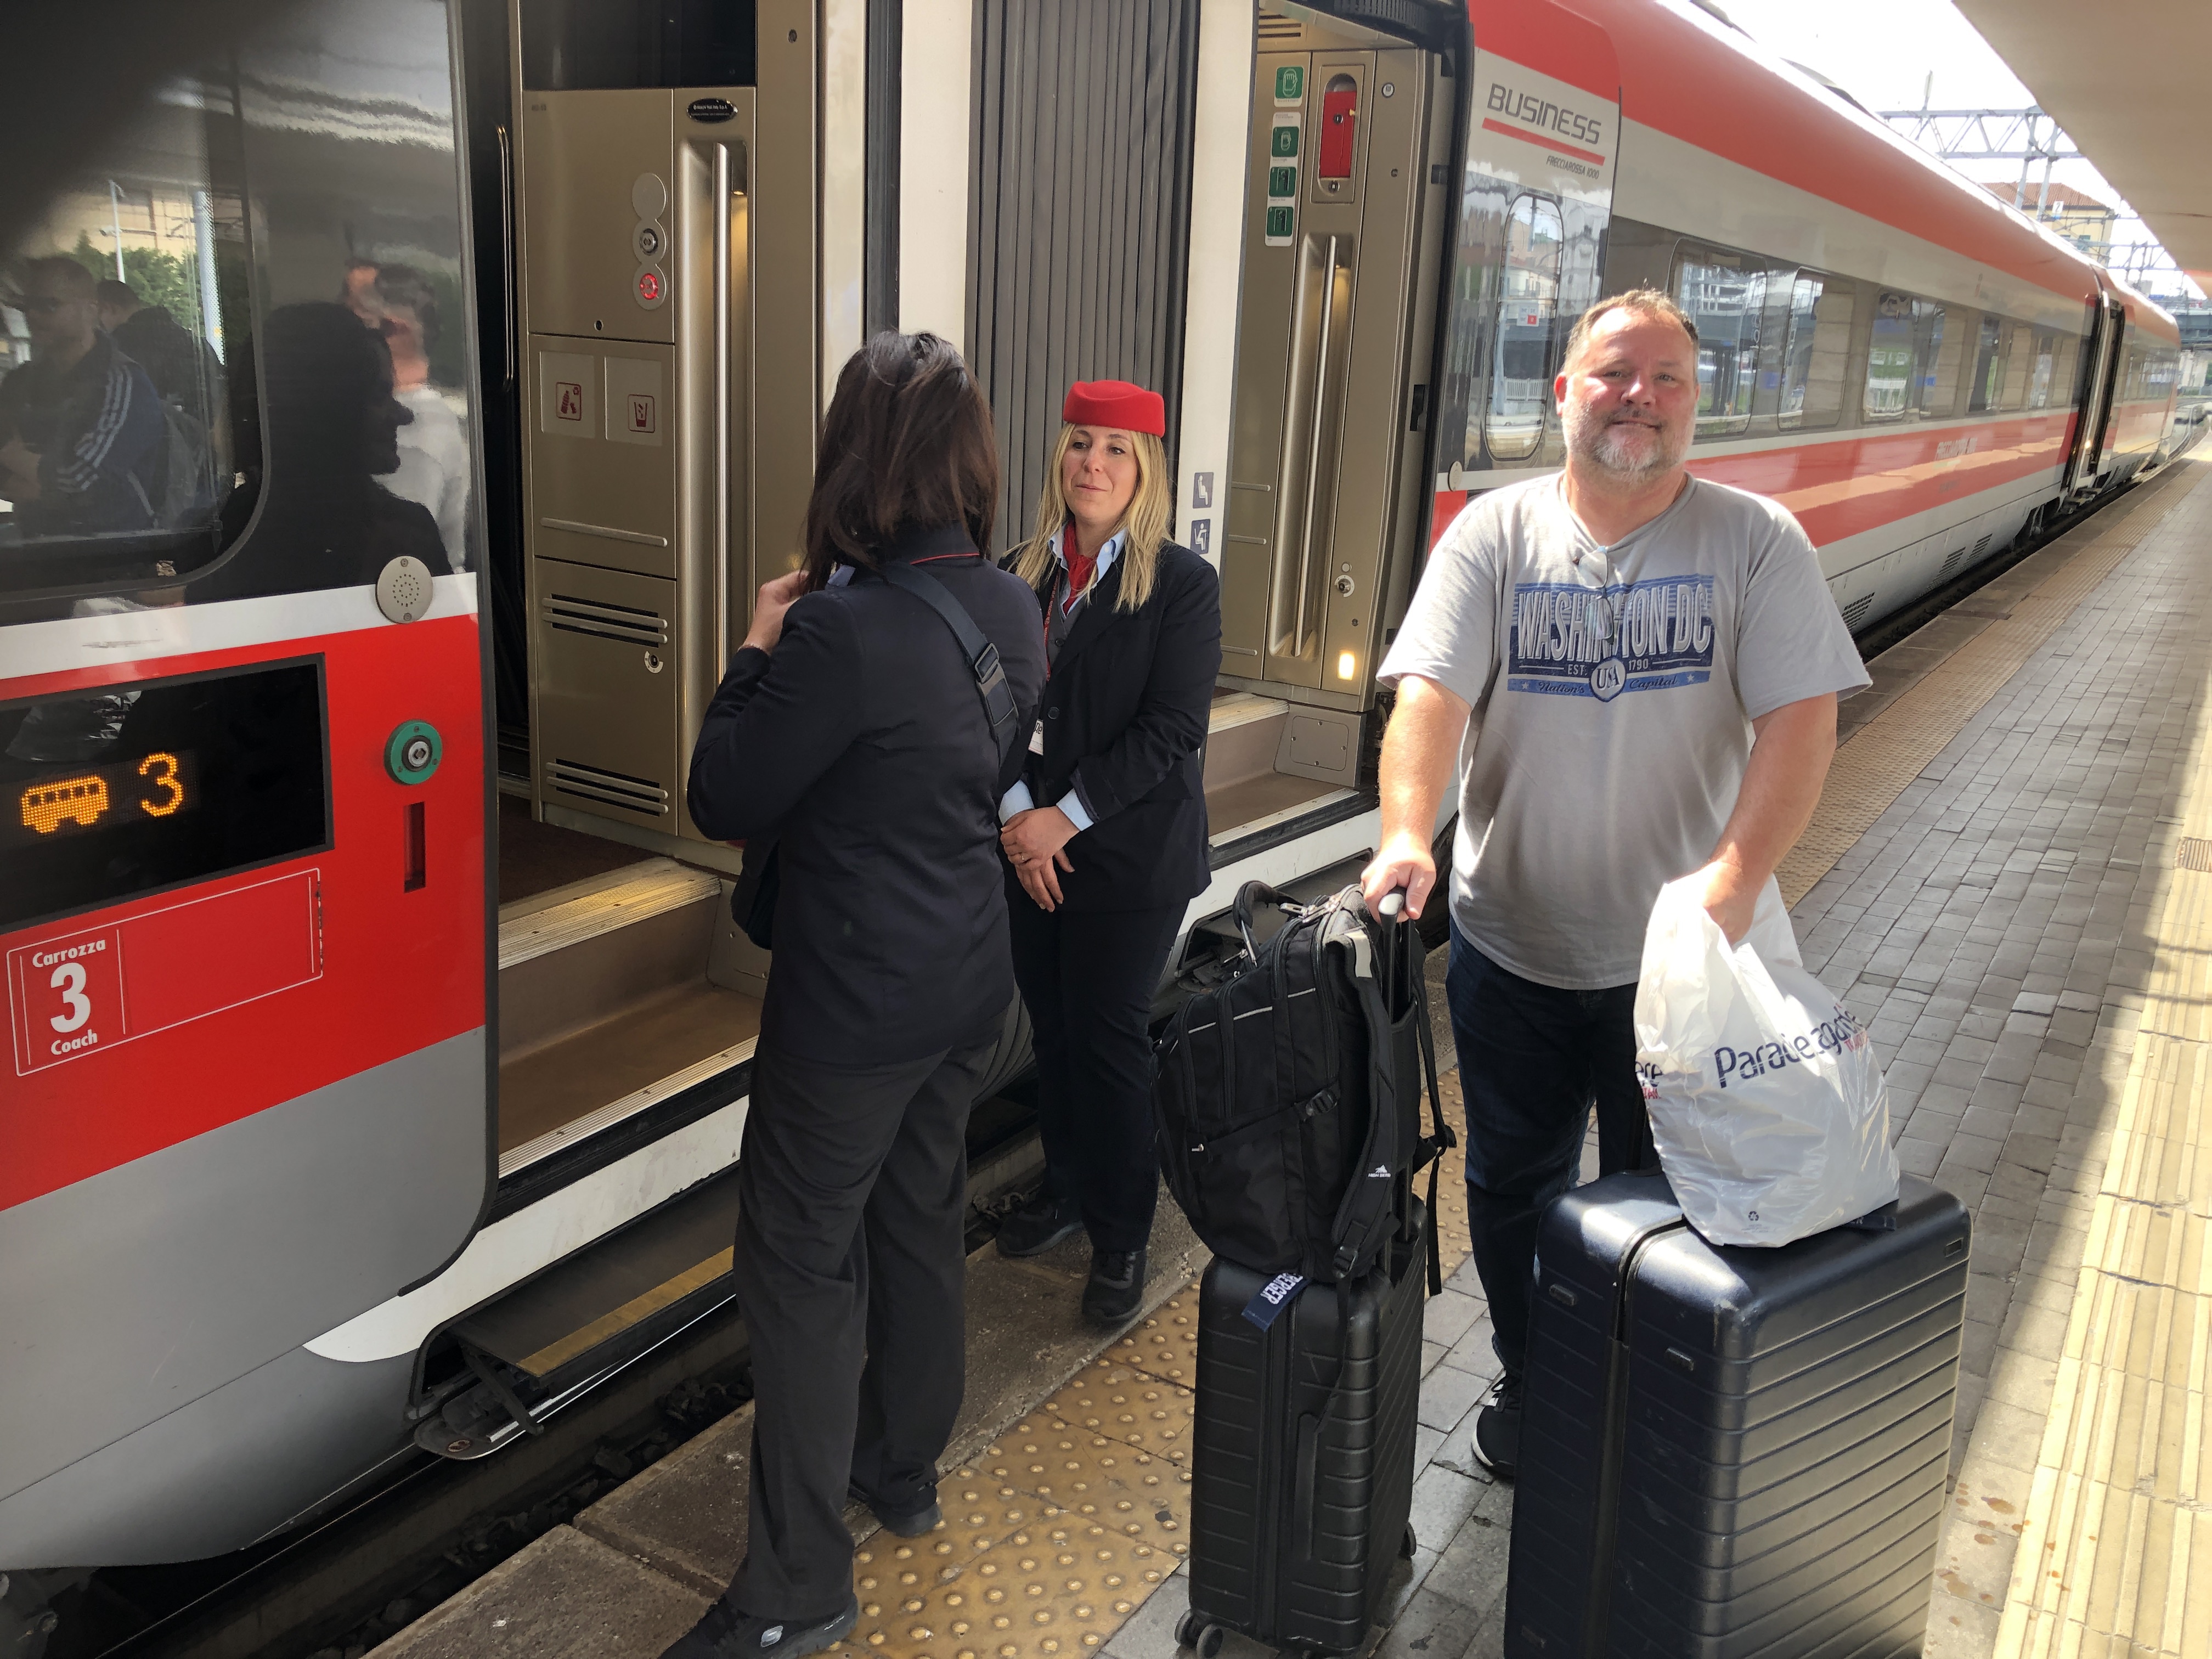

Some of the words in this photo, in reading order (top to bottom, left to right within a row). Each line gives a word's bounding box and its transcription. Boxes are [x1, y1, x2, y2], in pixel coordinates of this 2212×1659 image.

[1487, 82, 1602, 145] BUSINESS
[1547, 155, 1585, 176] FRECCIAROSSA
[1587, 167, 1600, 180] 1000
[1673, 583, 1713, 654] DC
[1628, 658, 1649, 670] 1790
[1596, 665, 1622, 691] USA
[1629, 675, 1678, 690] Capital
[139, 752, 184, 817] 3
[32, 939, 106, 968] Carrozza
[50, 962, 91, 1033] 3
[50, 1029, 98, 1055] Coach
